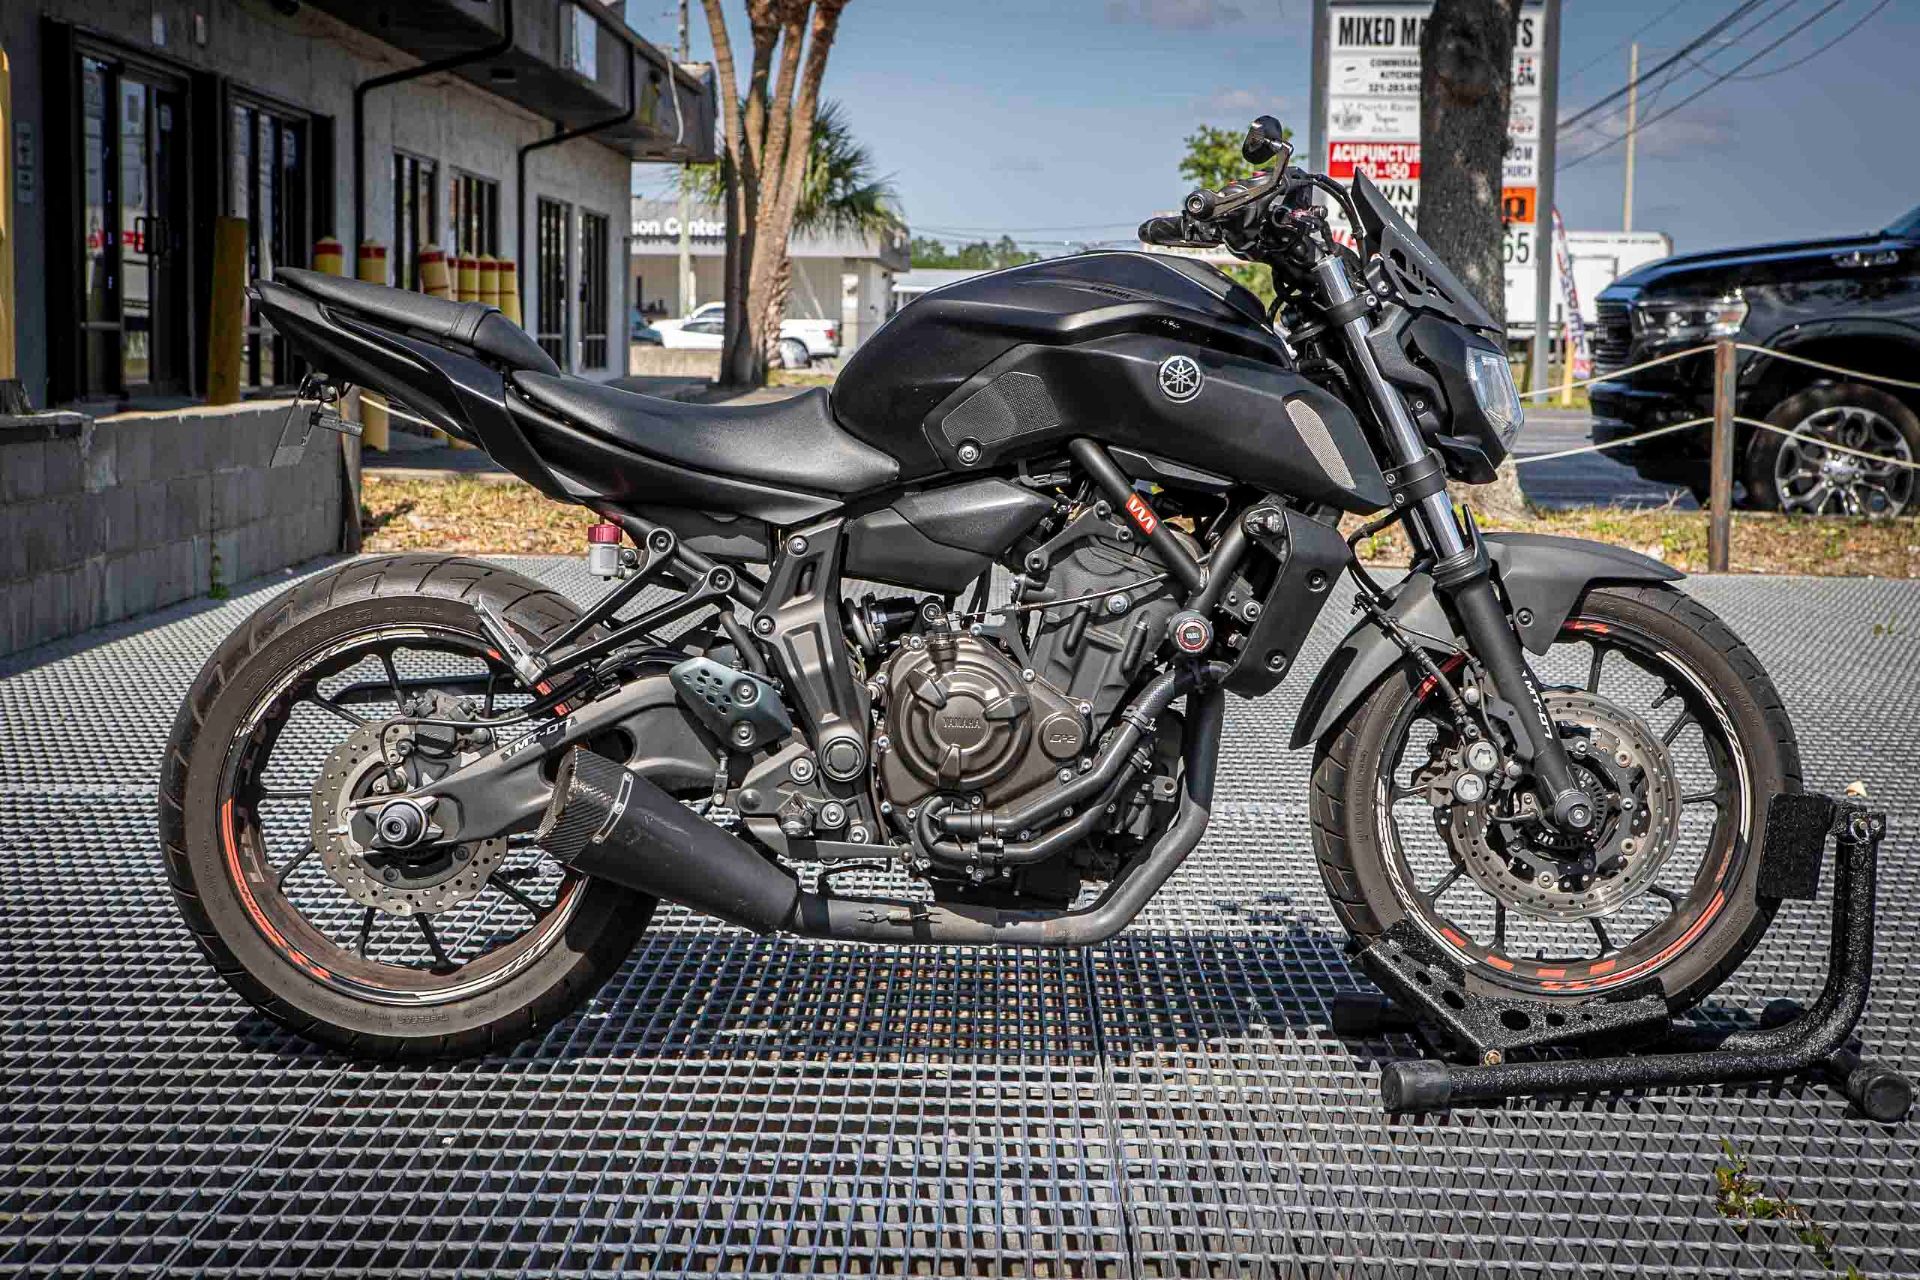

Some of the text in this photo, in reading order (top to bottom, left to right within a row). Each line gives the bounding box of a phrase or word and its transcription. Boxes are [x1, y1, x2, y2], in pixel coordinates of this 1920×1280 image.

[1339, 17, 1395, 46] MIXED
[943, 716, 981, 729] YAMAHA
[1524, 680, 1553, 740] MT-07
[514, 717, 573, 753] MT-07
